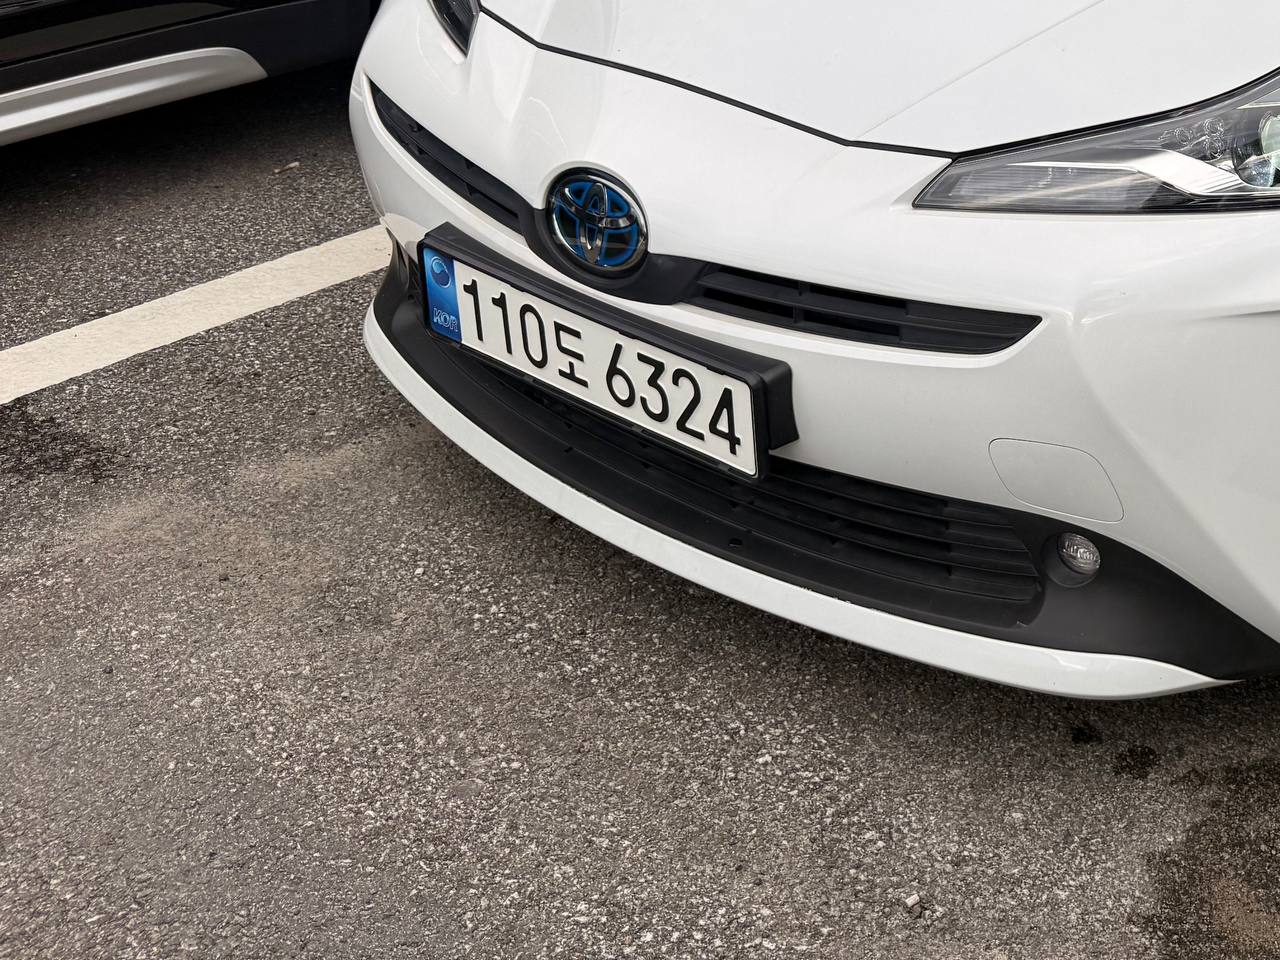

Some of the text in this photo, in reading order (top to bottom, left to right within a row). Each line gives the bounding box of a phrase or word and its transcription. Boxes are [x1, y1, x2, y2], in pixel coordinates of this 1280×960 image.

[432, 307, 459, 333] KOR
[462, 278, 742, 456] 110도 6324
